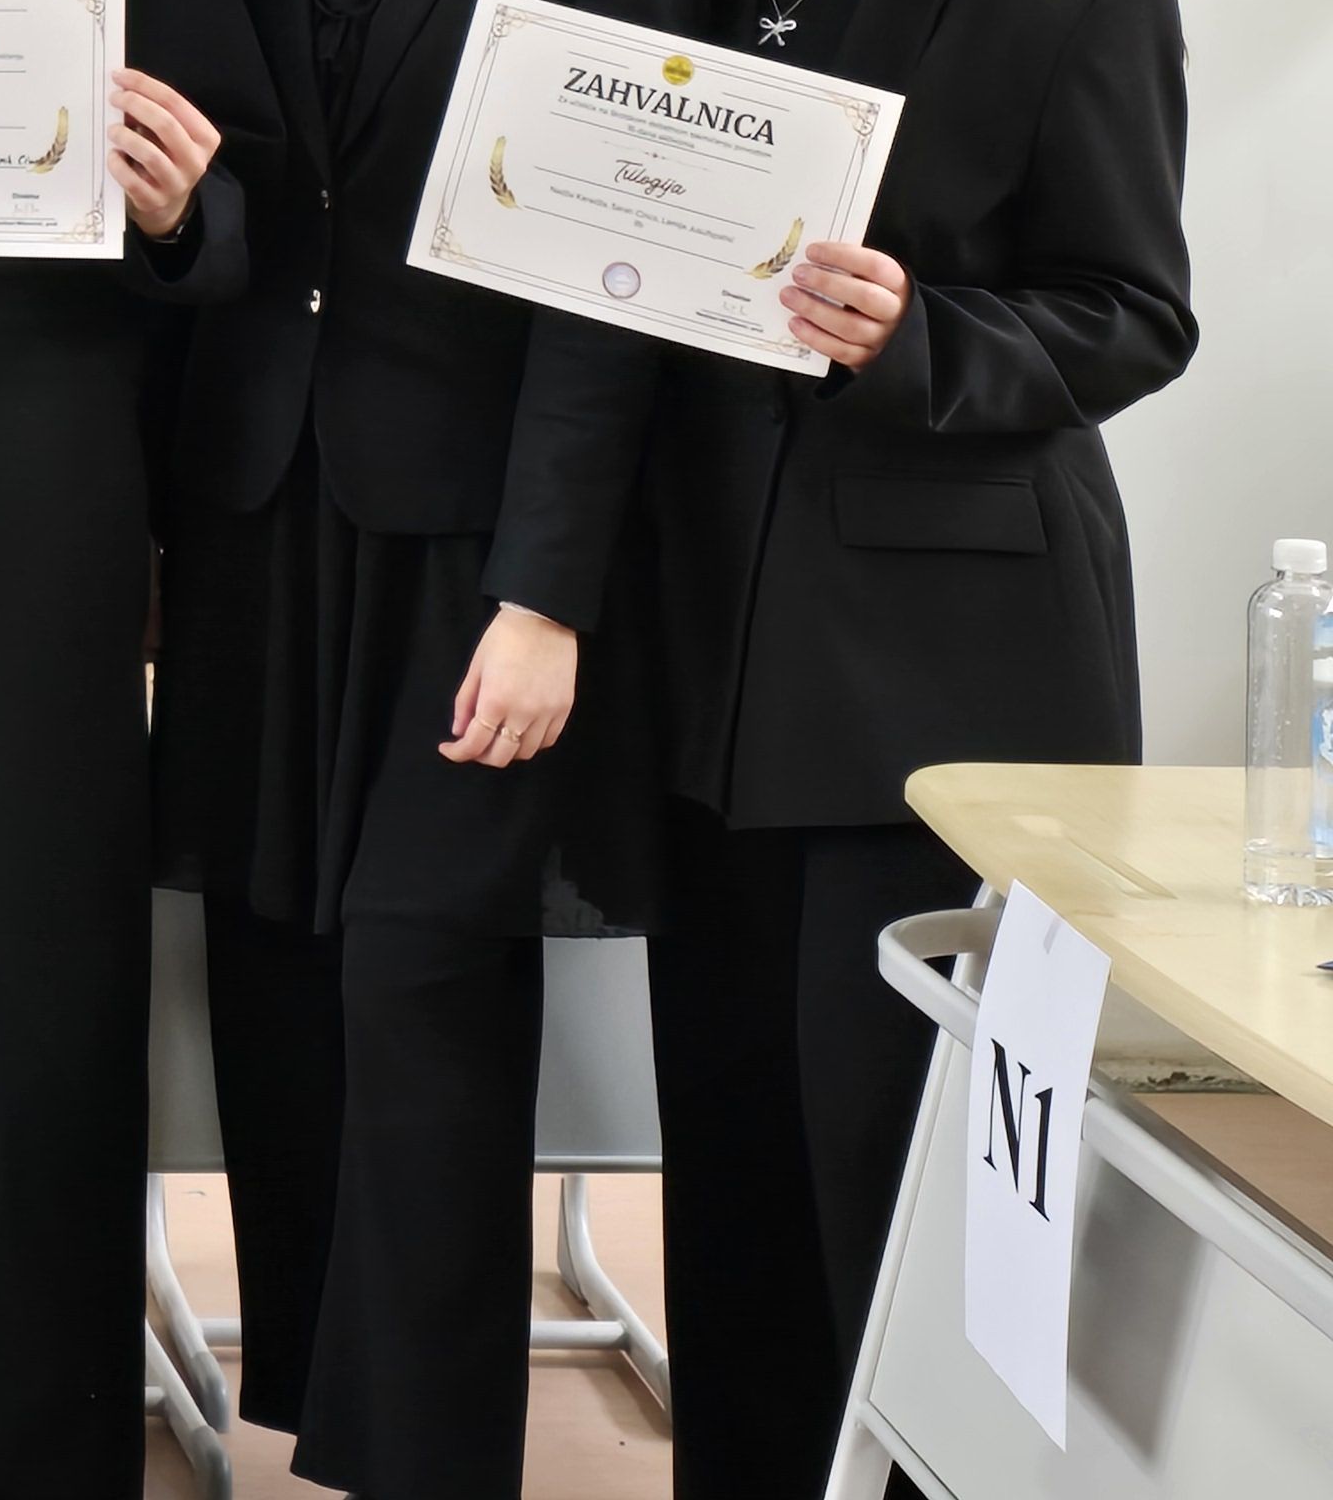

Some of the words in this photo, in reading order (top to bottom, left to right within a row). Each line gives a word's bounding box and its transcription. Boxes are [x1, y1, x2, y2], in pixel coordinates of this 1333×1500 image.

[563, 67, 776, 146] ZAHVALNICA
[615, 158, 687, 198] Trilogija
[983, 1037, 1054, 1223] N1
